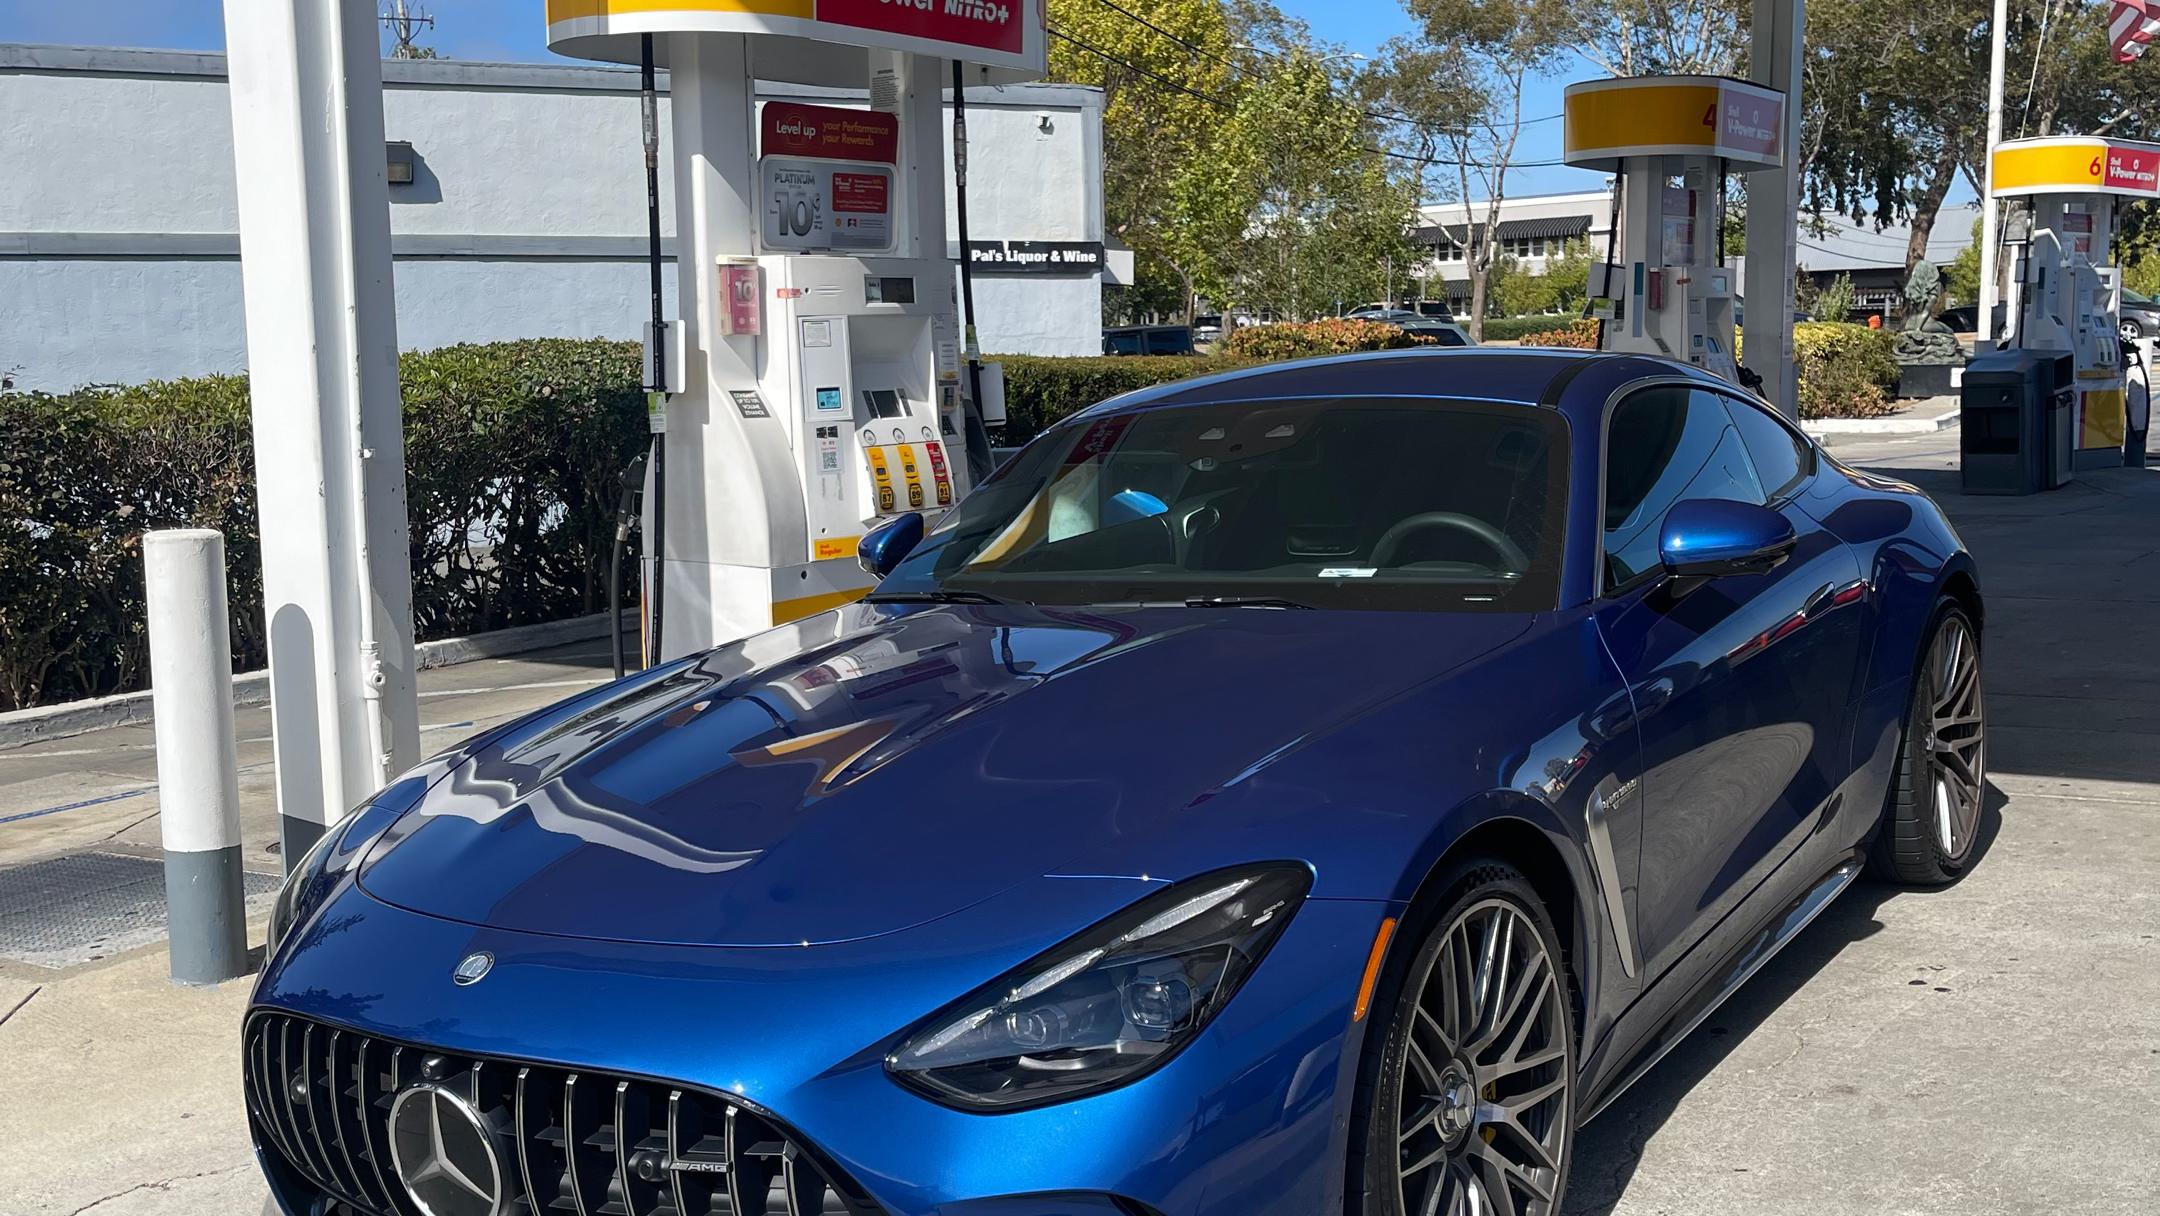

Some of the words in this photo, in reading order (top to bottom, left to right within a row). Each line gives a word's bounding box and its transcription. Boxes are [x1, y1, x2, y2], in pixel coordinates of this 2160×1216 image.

[1702, 104, 1717, 132] 4
[776, 120, 801, 135] Level
[803, 128, 816, 140] up
[822, 122, 841, 132] your
[842, 121, 889, 136] Performance
[822, 135, 840, 145] your
[842, 133, 874, 146] Rewards
[2089, 156, 2101, 177] 6
[774, 173, 816, 185] PLATINUM
[971, 249, 1003, 262] Pal's
[1005, 250, 1049, 265] Liquor
[1050, 251, 1061, 262] &
[1062, 250, 1097, 263] Wine
[734, 281, 756, 301] 10
[882, 492, 891, 503] 87
[911, 490, 921, 500] 89
[939, 487, 948, 498] 91
[687, 1163, 727, 1173] AMG
